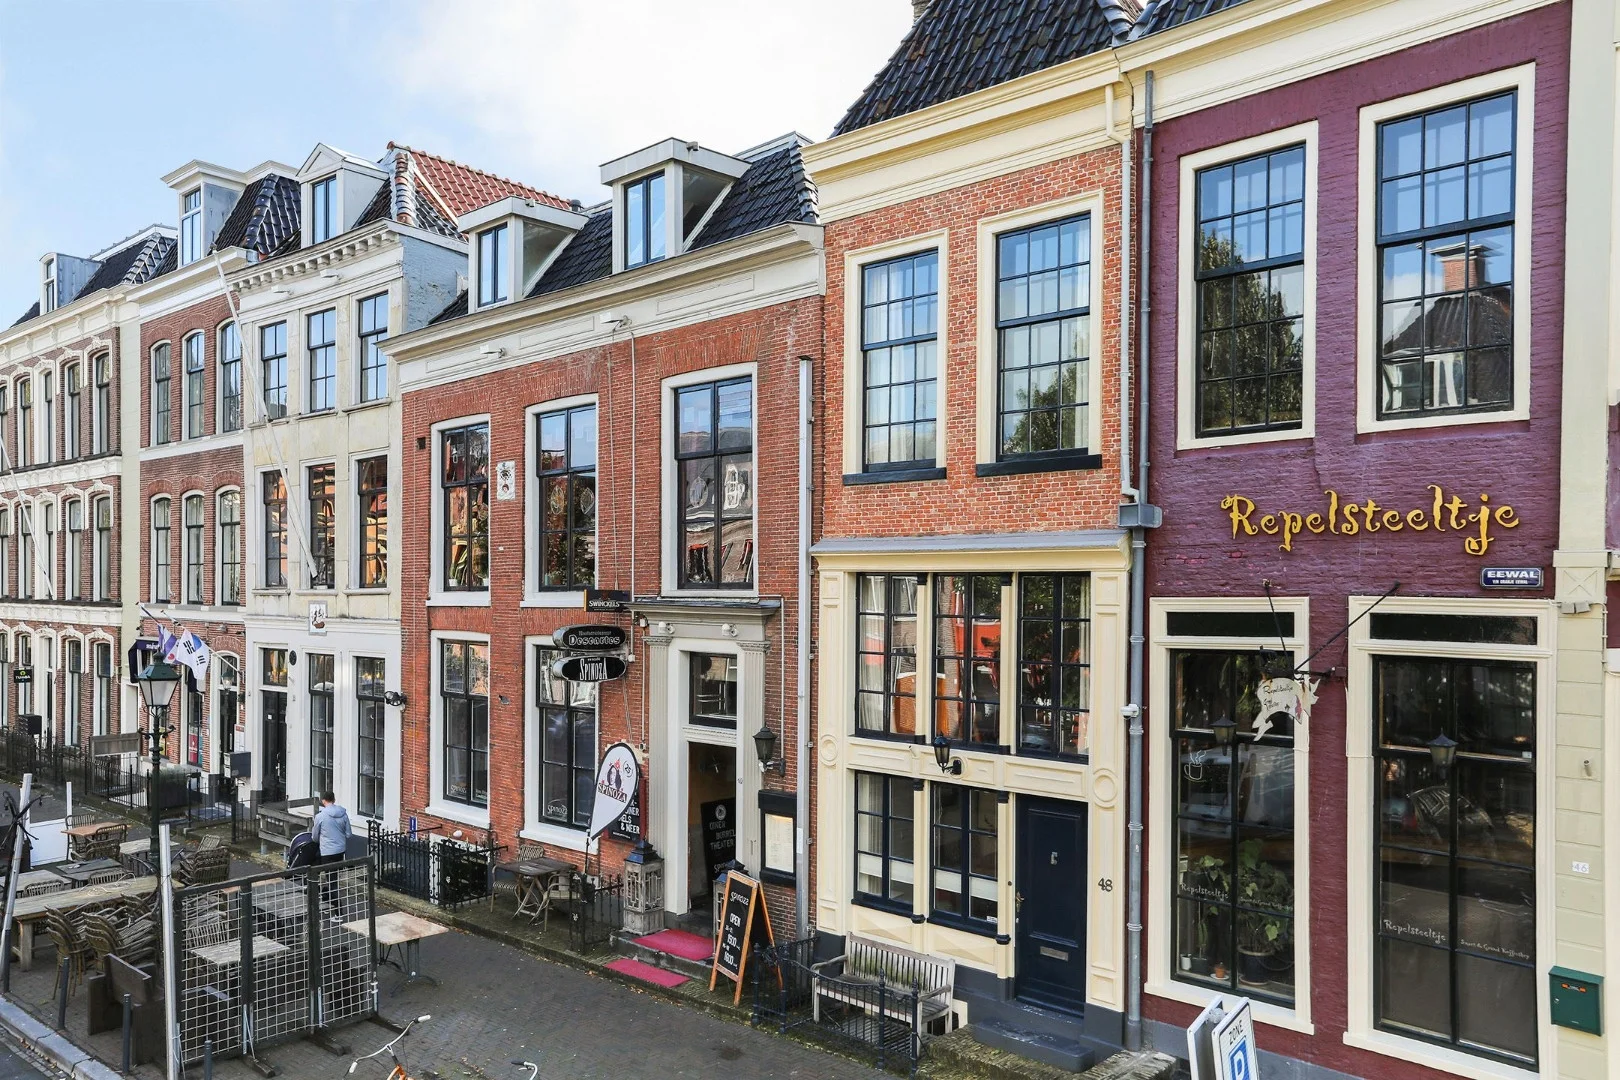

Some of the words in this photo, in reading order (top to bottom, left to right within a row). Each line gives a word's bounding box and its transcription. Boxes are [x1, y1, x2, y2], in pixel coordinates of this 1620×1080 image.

[1221, 485, 1519, 555] Repelsteeltje
[569, 635, 620, 645] Descartes
[579, 658, 608, 680] SPINOZA
[597, 782, 628, 803] SPINOZA
[710, 839, 734, 851] THEATER
[1574, 863, 1588, 873] 46
[1098, 878, 1113, 892] 48
[730, 912, 741, 927] OPEN
[1383, 918, 1447, 944] Repelsteeltje
[1228, 1020, 1244, 1046] ZONE
